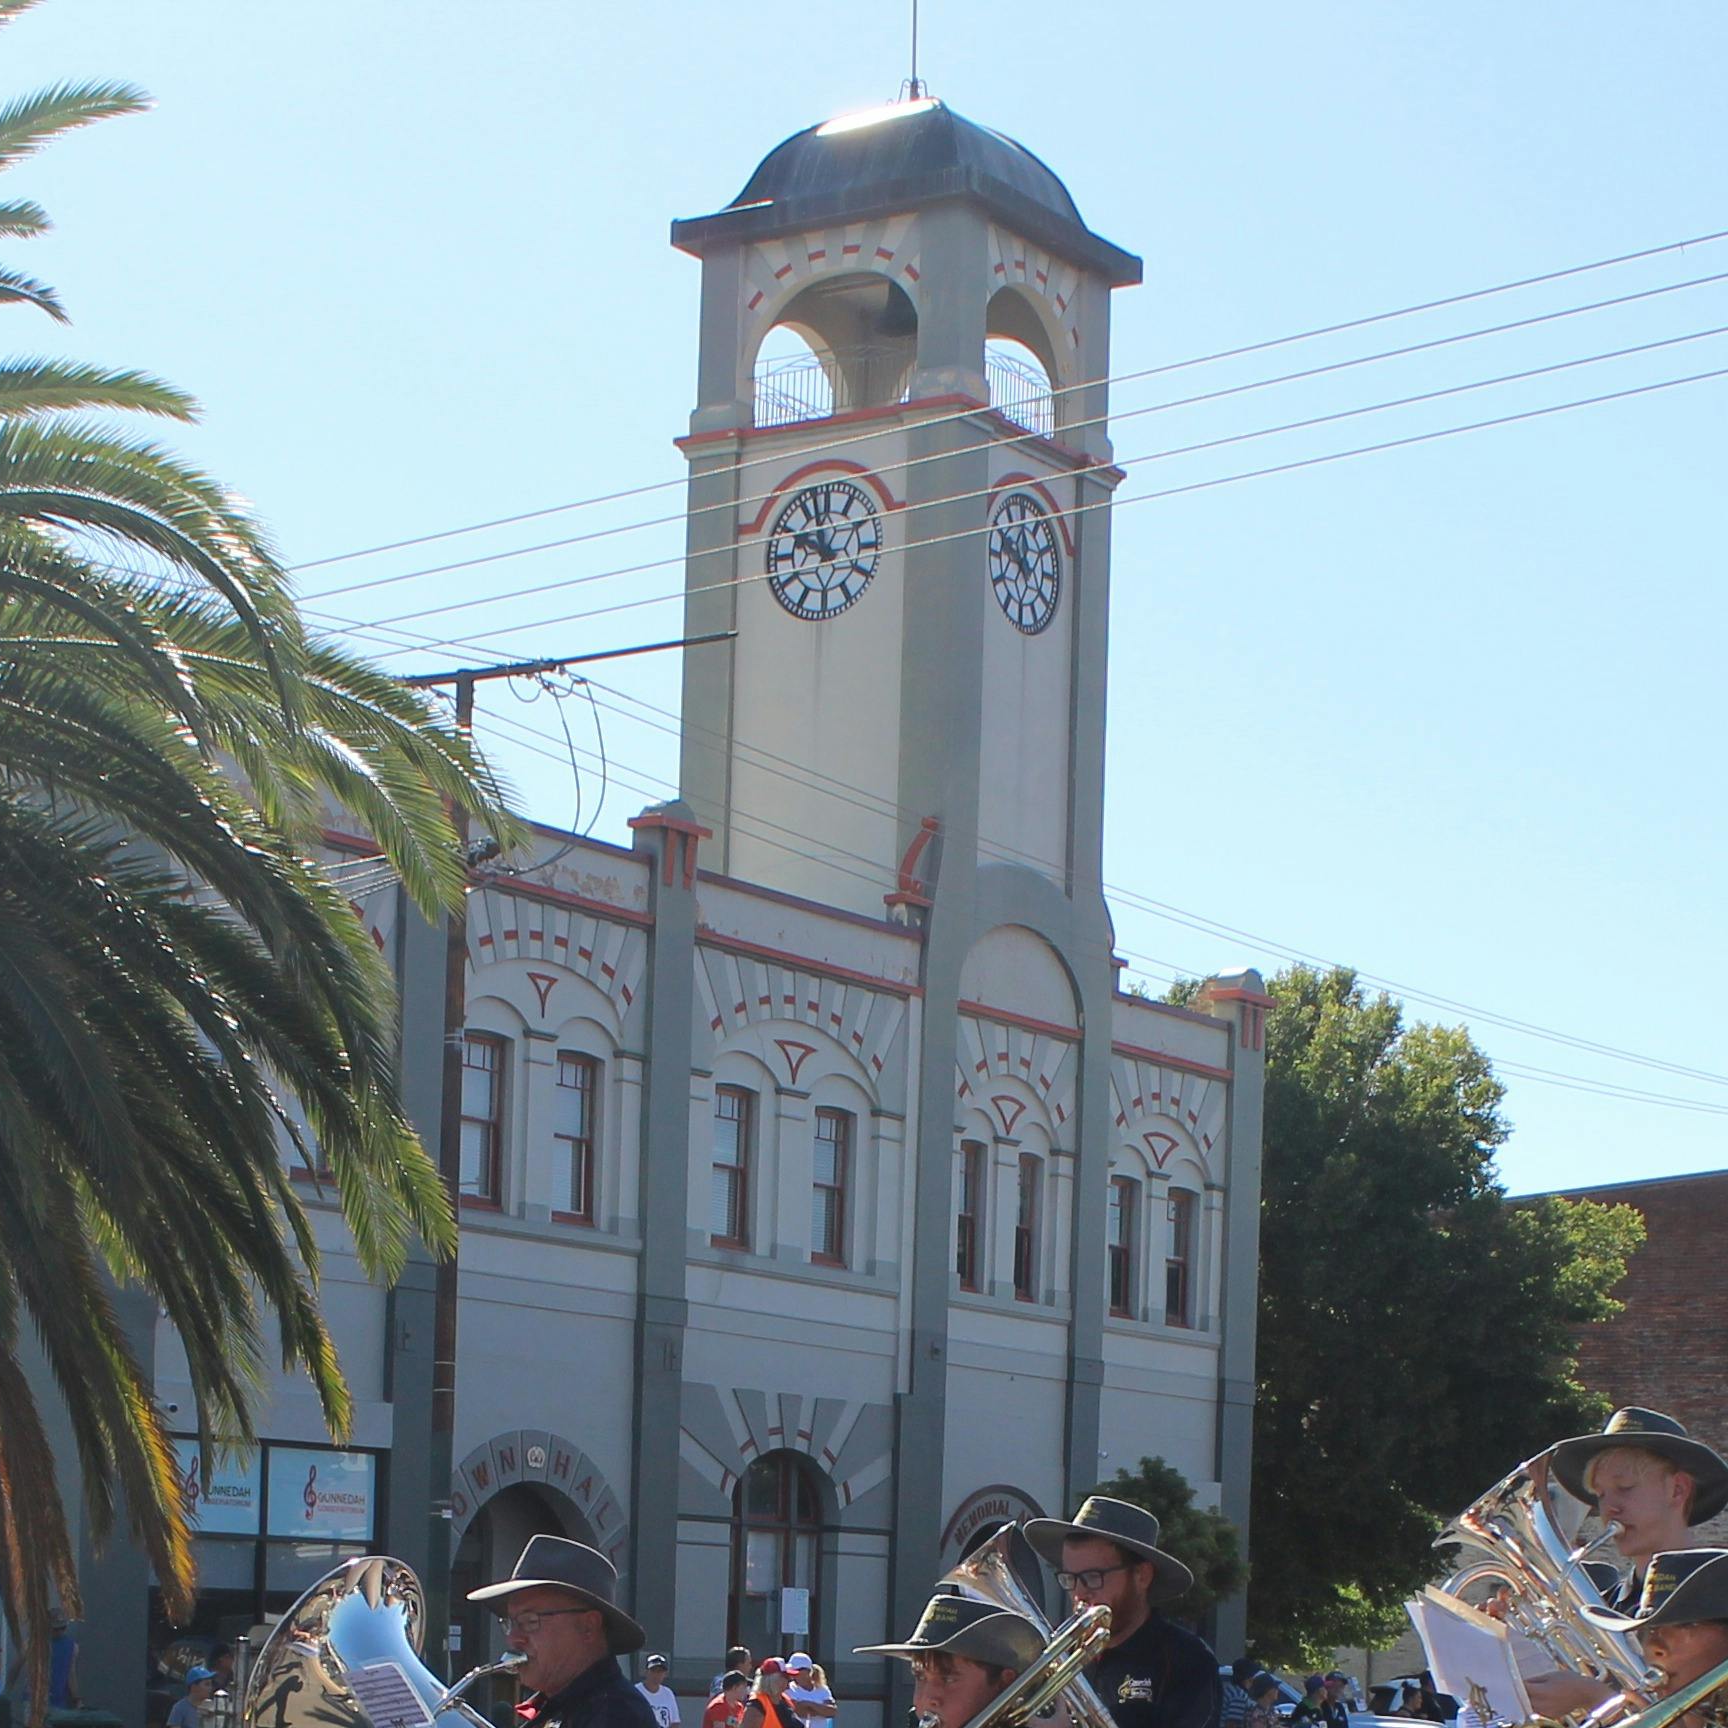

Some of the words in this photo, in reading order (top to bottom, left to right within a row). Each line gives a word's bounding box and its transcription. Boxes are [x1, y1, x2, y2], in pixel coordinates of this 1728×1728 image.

[318, 1491, 365, 1505] GUNNEDAH
[553, 1450, 623, 1568] HALL
[954, 1500, 1012, 1546] MEMORIAL
